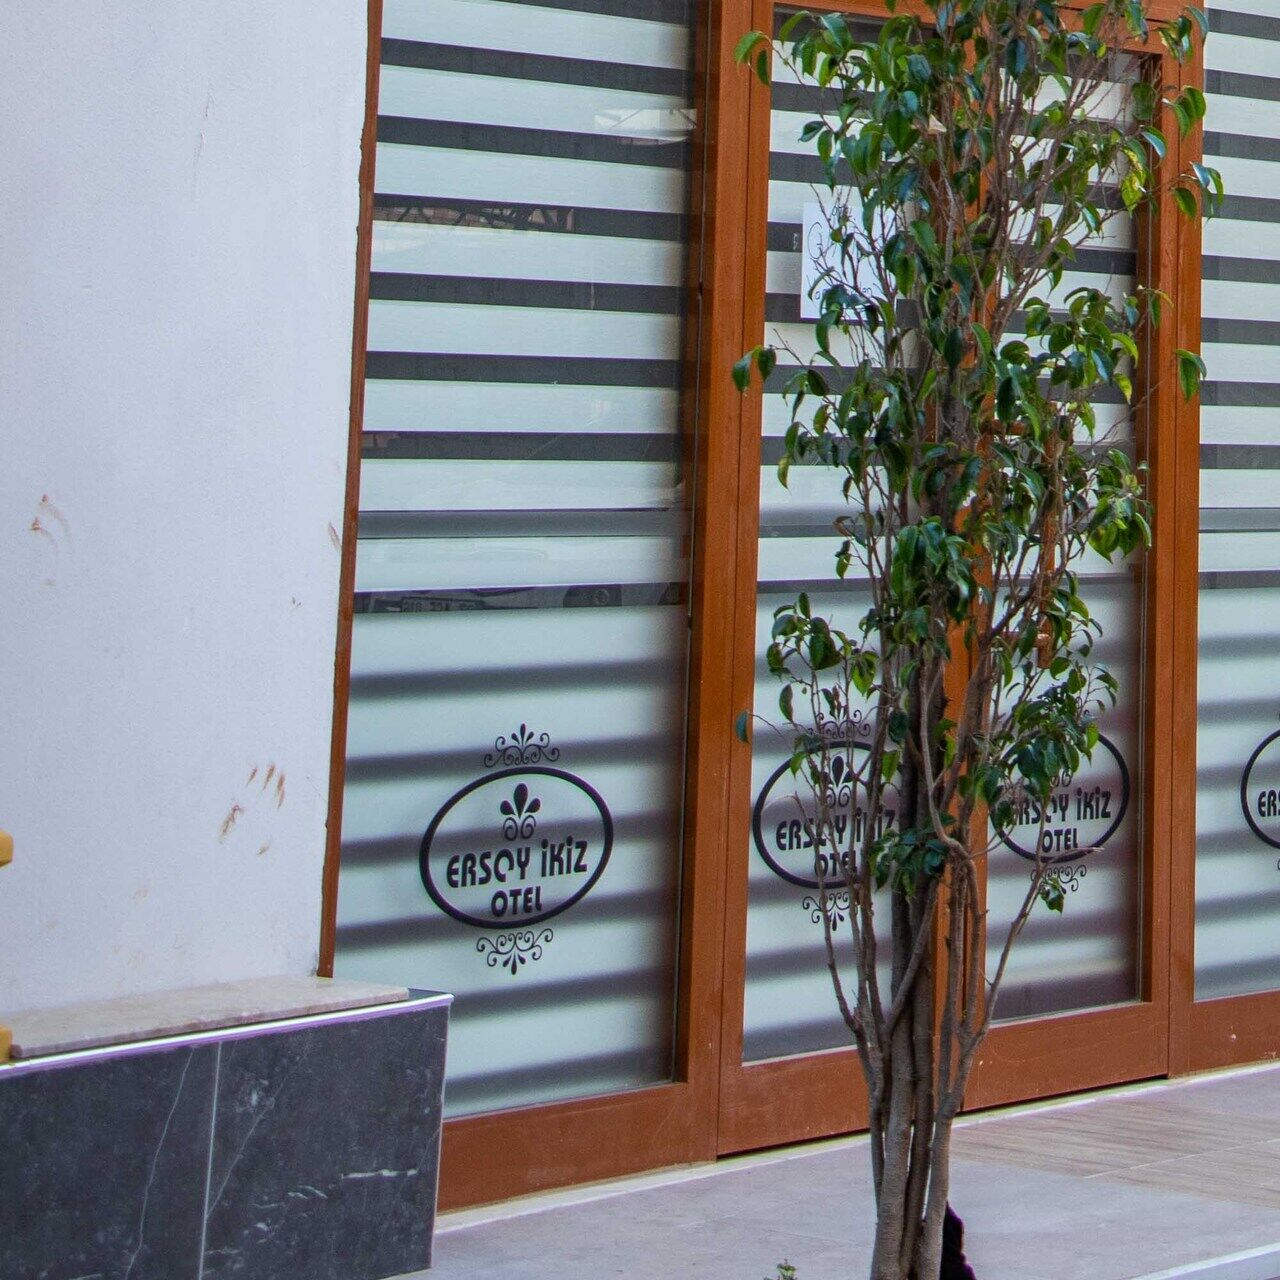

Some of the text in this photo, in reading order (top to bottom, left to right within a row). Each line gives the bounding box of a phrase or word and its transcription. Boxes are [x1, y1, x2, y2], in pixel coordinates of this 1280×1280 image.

[1076, 786, 1112, 821] İKİZ
[1041, 828, 1079, 853] OTEL
[446, 835, 588, 889] ERSOY İKİZ
[491, 887, 543, 917] OTEL
